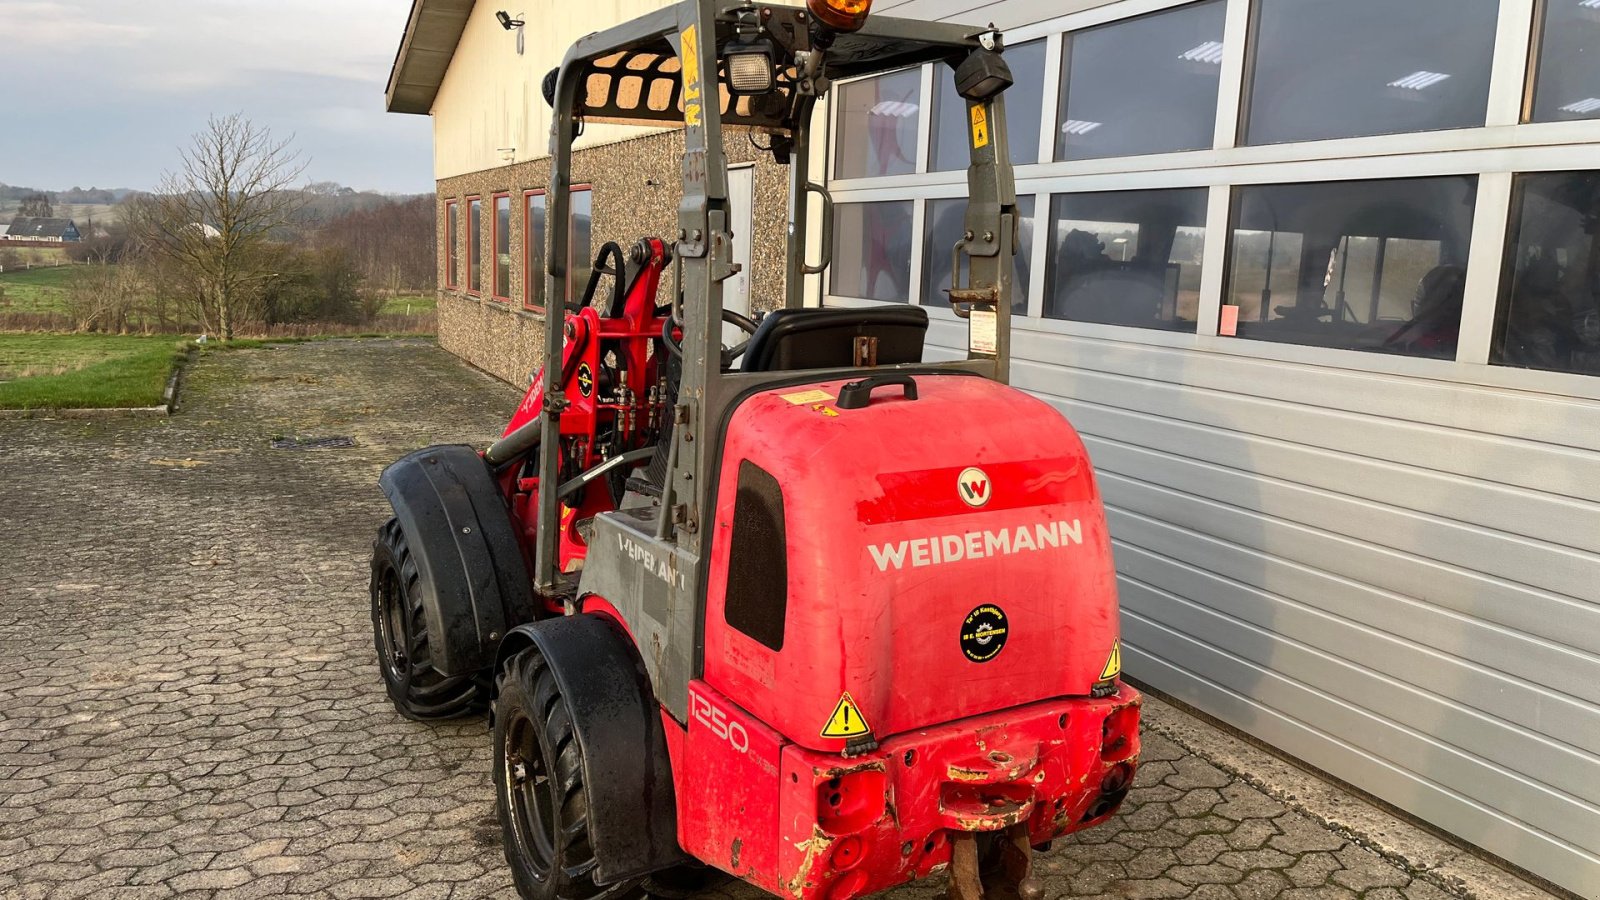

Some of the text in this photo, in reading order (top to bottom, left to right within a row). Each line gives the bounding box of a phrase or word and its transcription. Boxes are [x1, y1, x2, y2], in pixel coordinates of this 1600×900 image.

[961, 480, 986, 499] W
[867, 519, 1083, 571] WEIDEMANN
[689, 689, 749, 753] 1250
